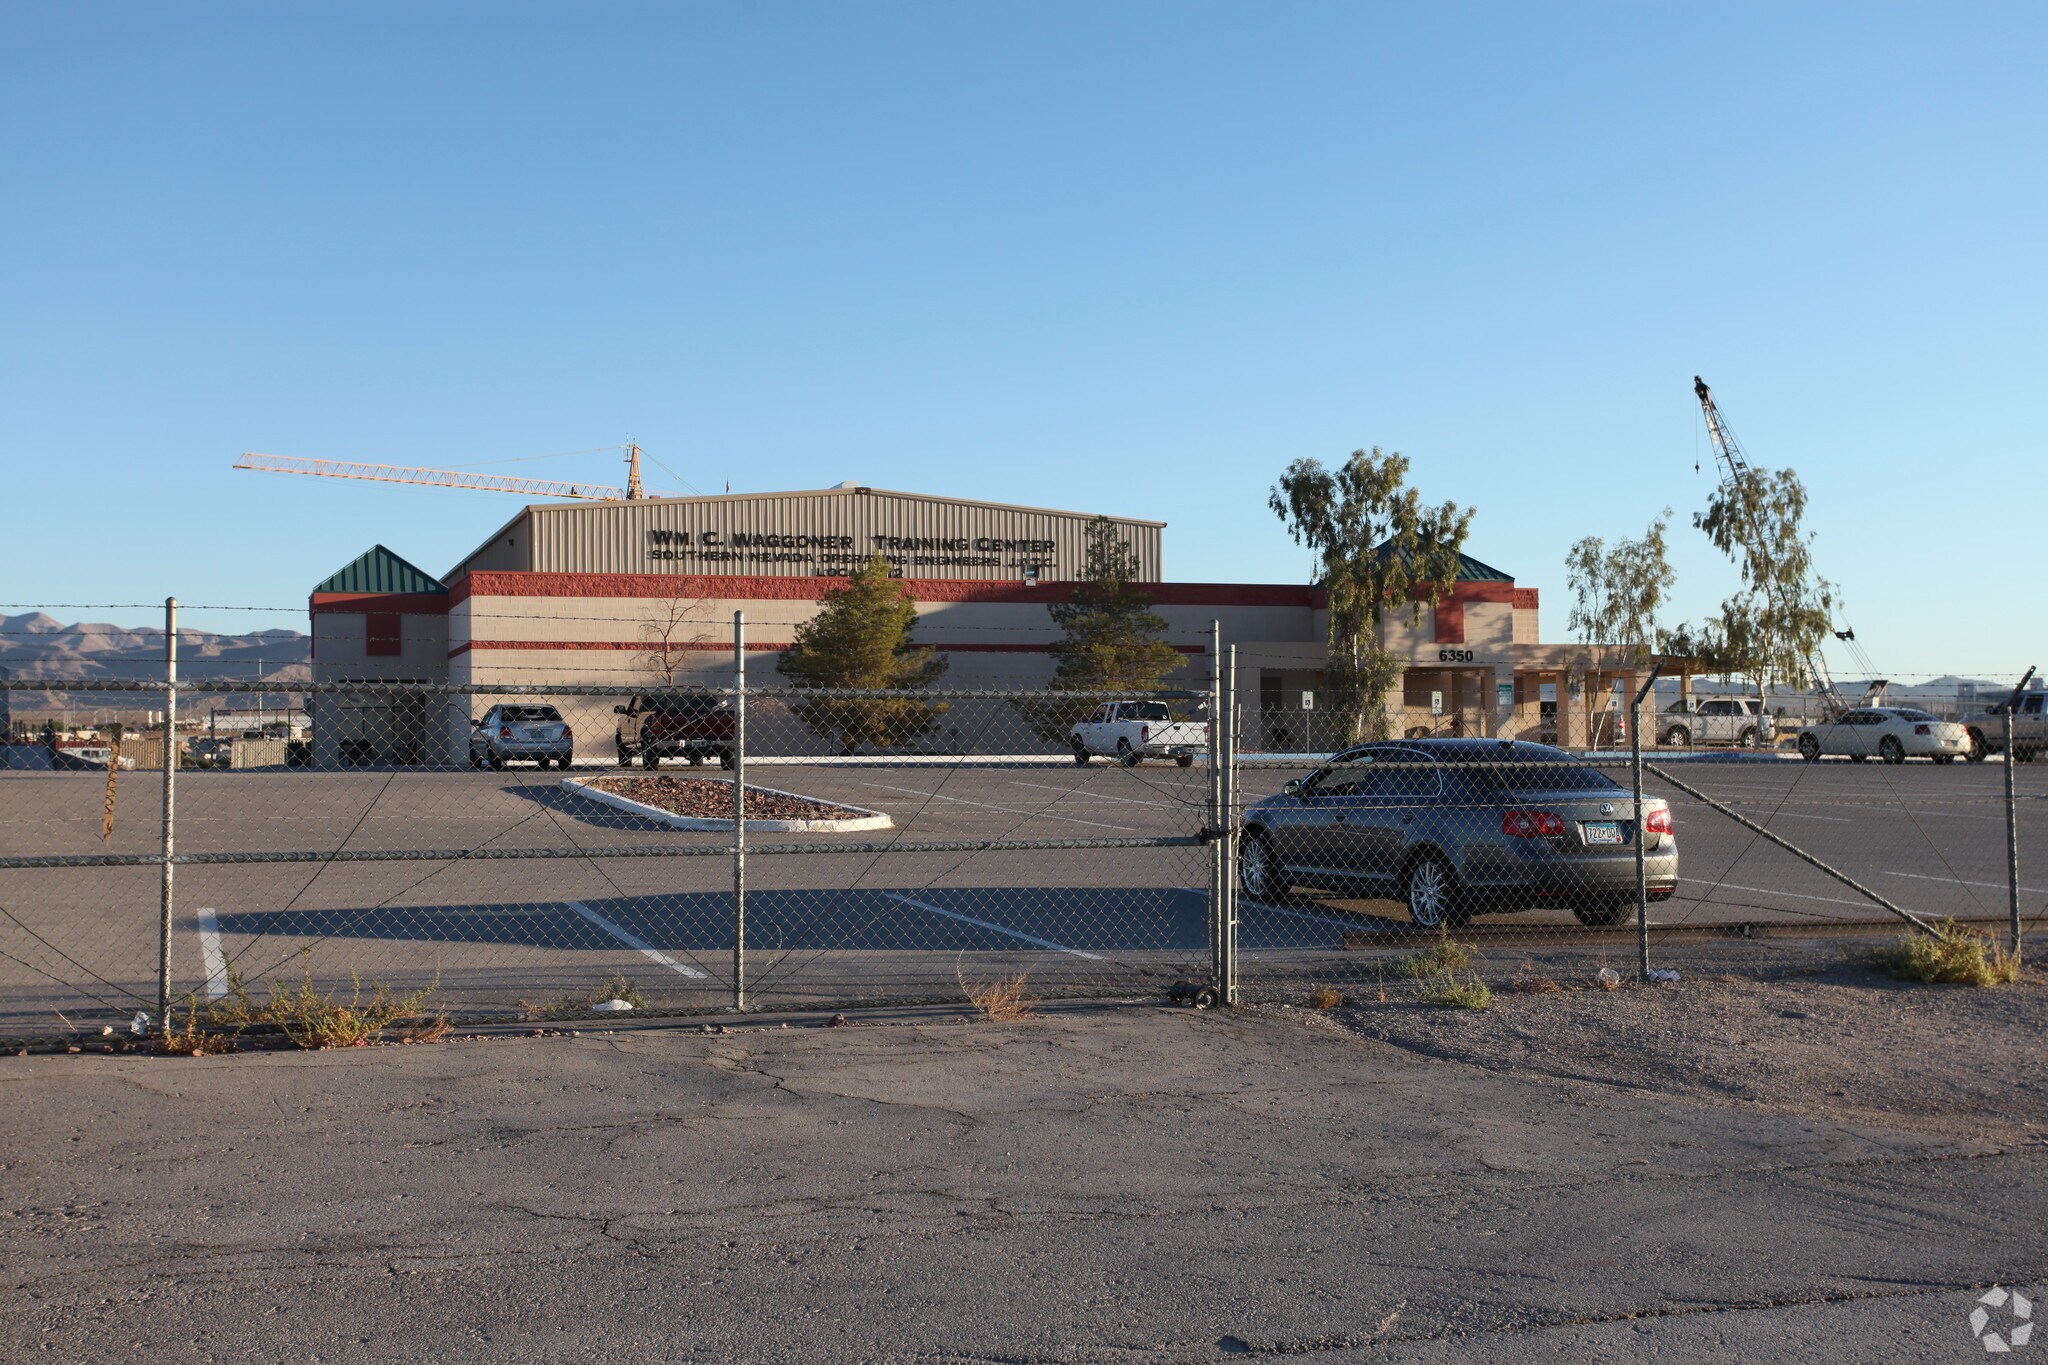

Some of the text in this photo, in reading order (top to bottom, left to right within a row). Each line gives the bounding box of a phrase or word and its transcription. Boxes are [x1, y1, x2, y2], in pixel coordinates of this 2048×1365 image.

[652, 529, 1056, 553] WM. C. WAGGONER TRAINING CENTER
[651, 549, 1057, 568] SOUTHERN NEVADA OPERANG ENGINEERS J.AT.C.
[816, 567, 862, 577] LOC
[1438, 649, 1474, 662] 6350
